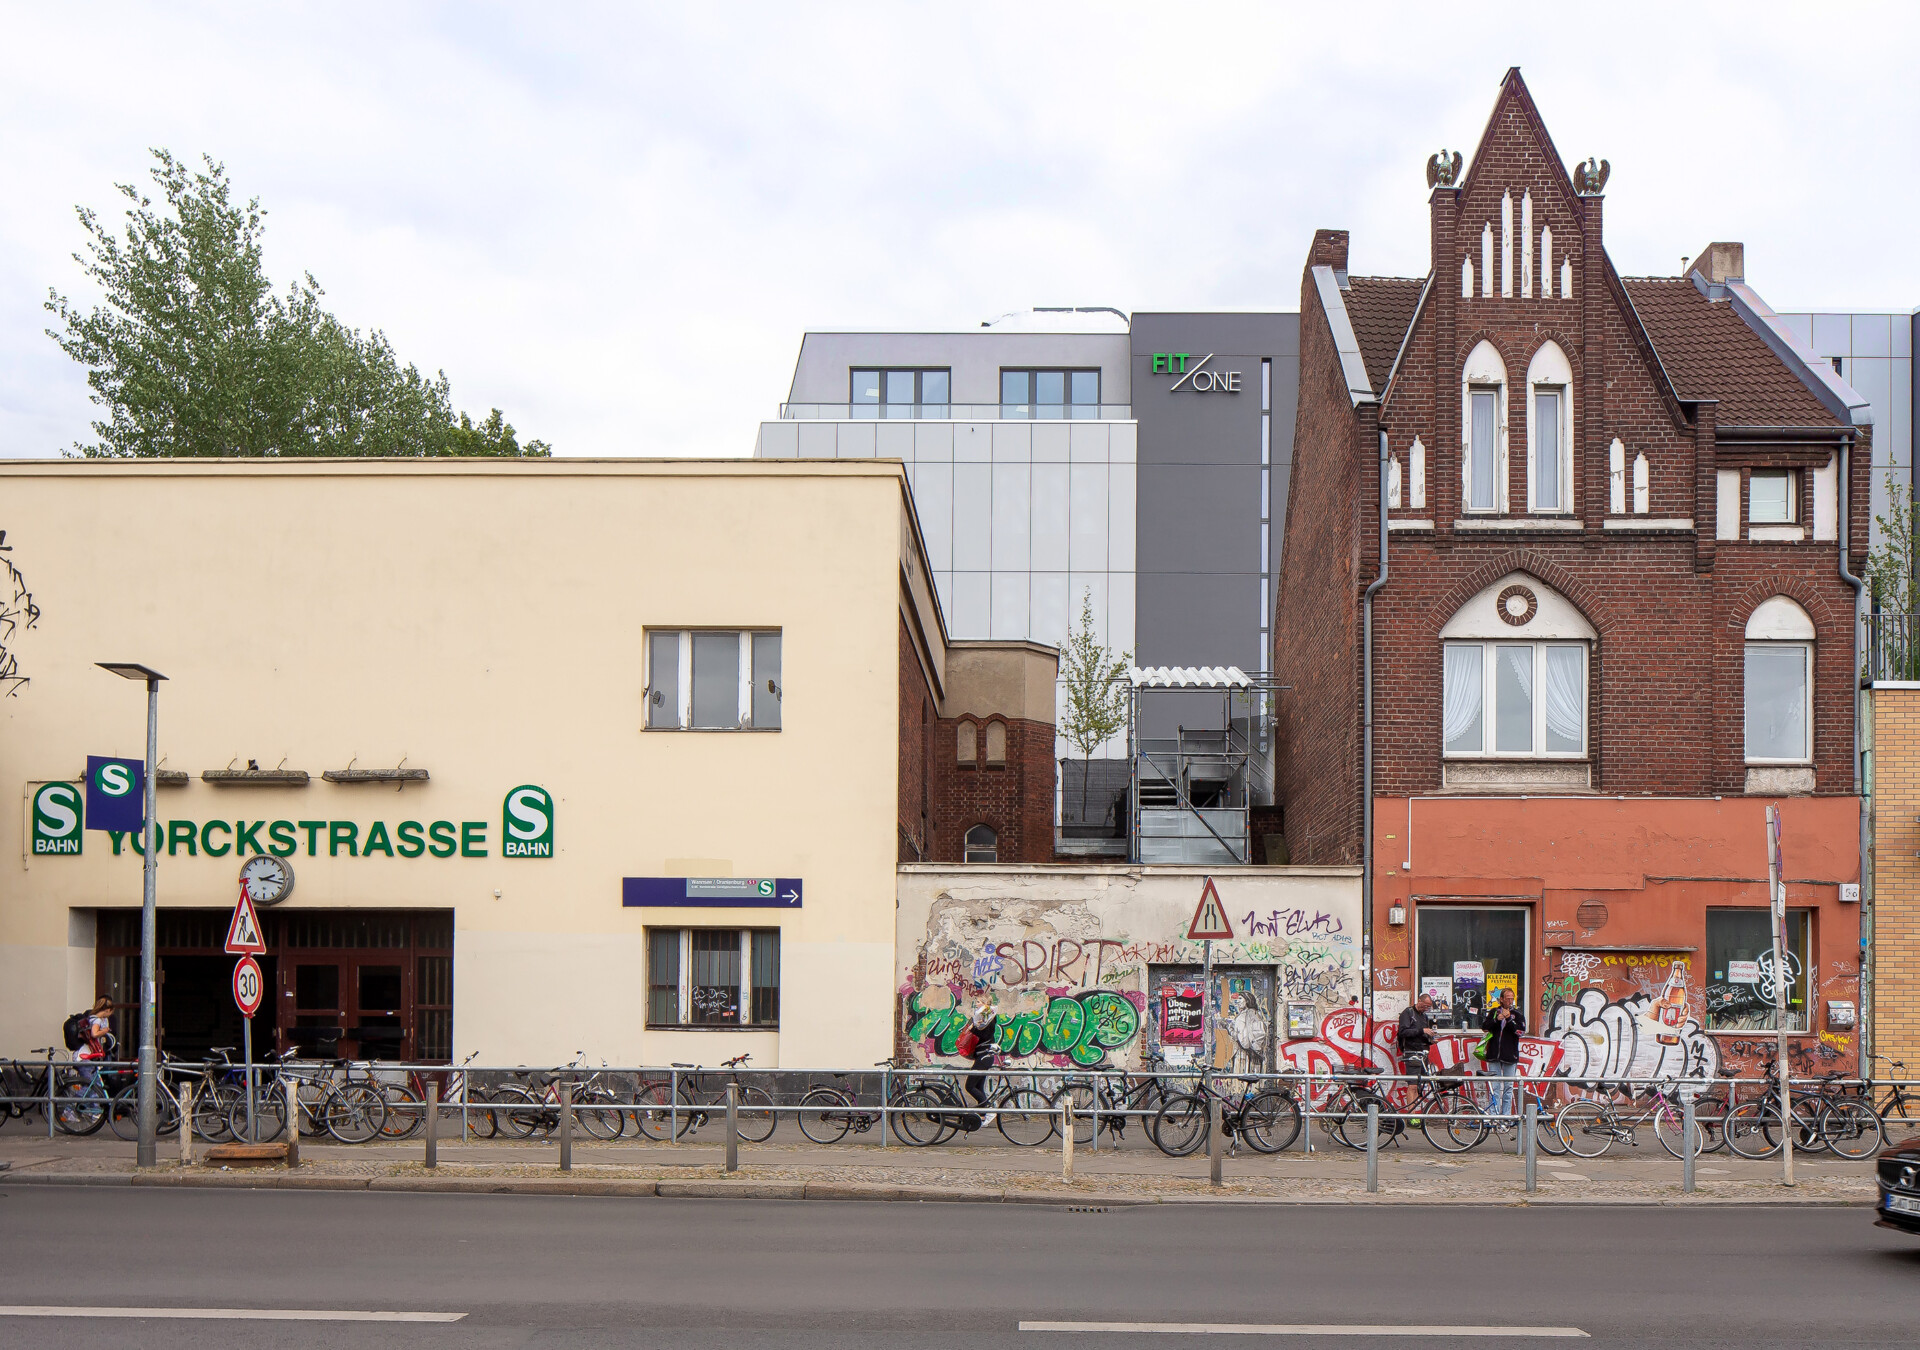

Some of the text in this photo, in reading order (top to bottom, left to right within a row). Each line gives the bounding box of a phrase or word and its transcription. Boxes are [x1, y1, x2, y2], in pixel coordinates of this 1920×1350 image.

[1153, 353, 1241, 391] FIT ONE
[102, 764, 130, 795] S
[37, 786, 77, 837] S
[508, 789, 549, 840] S
[35, 839, 79, 853] BAHN
[506, 842, 549, 856] BAHN
[239, 973, 257, 998] 30
[1167, 999, 1192, 1008] Über-
[1168, 1007, 1202, 1017] nehmen
[1168, 1014, 1189, 1023] wir?!
